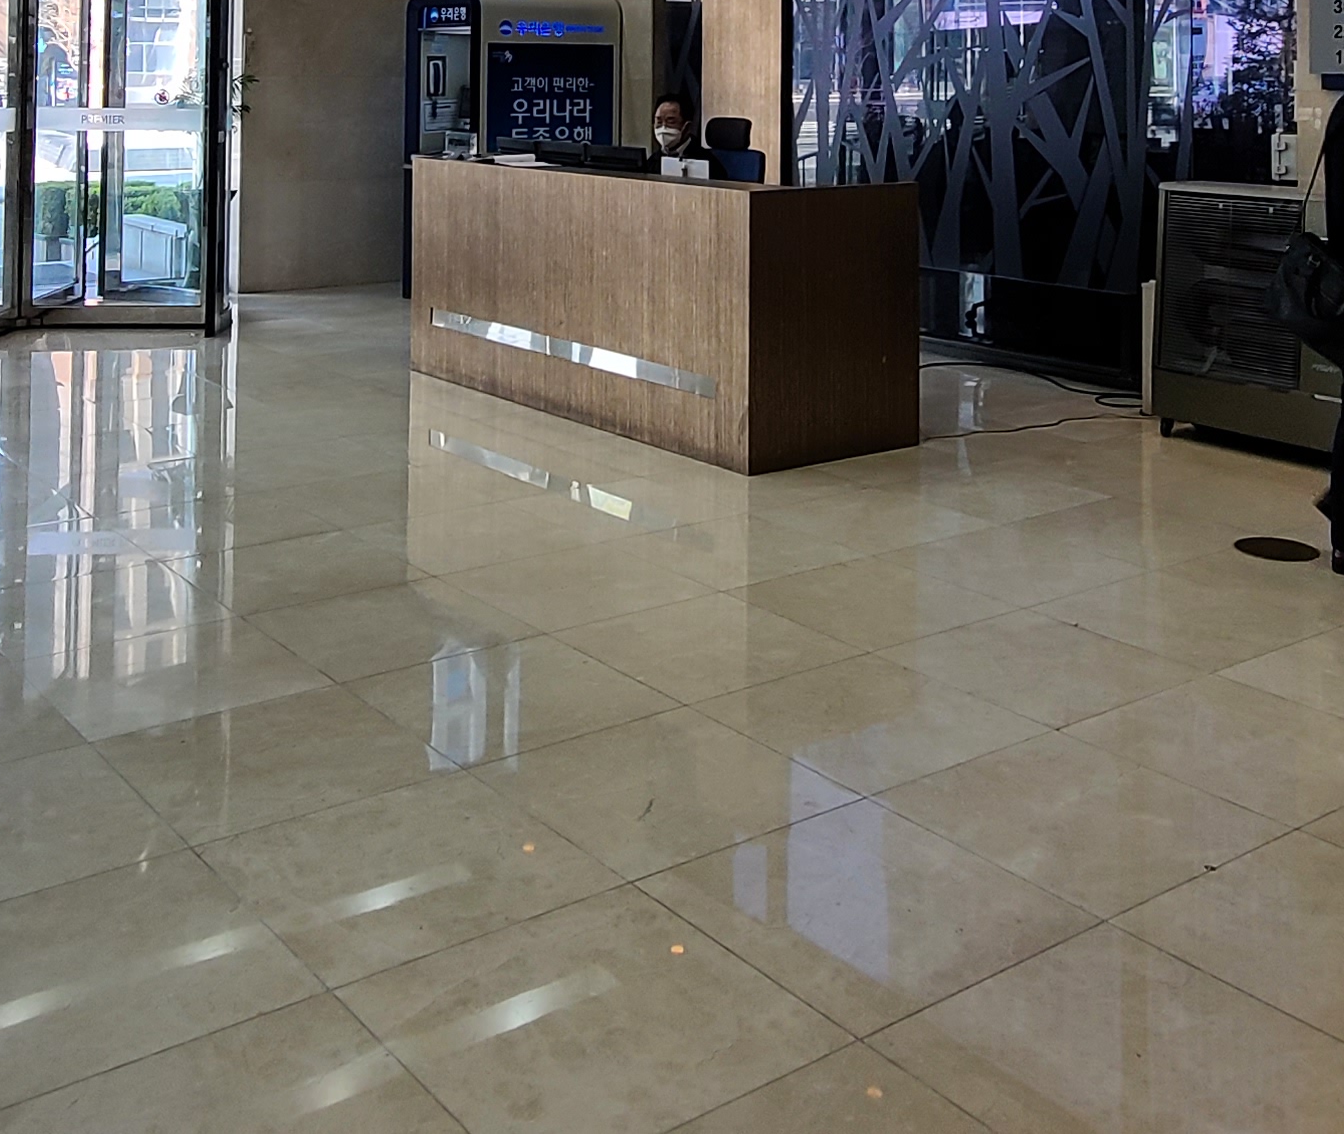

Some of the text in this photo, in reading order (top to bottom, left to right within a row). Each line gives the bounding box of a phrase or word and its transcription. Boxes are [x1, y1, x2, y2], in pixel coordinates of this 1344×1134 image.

[440, 6, 467, 22] 우리은행
[510, 76, 549, 93] 고객이
[510, 98, 593, 125] 우리나라
